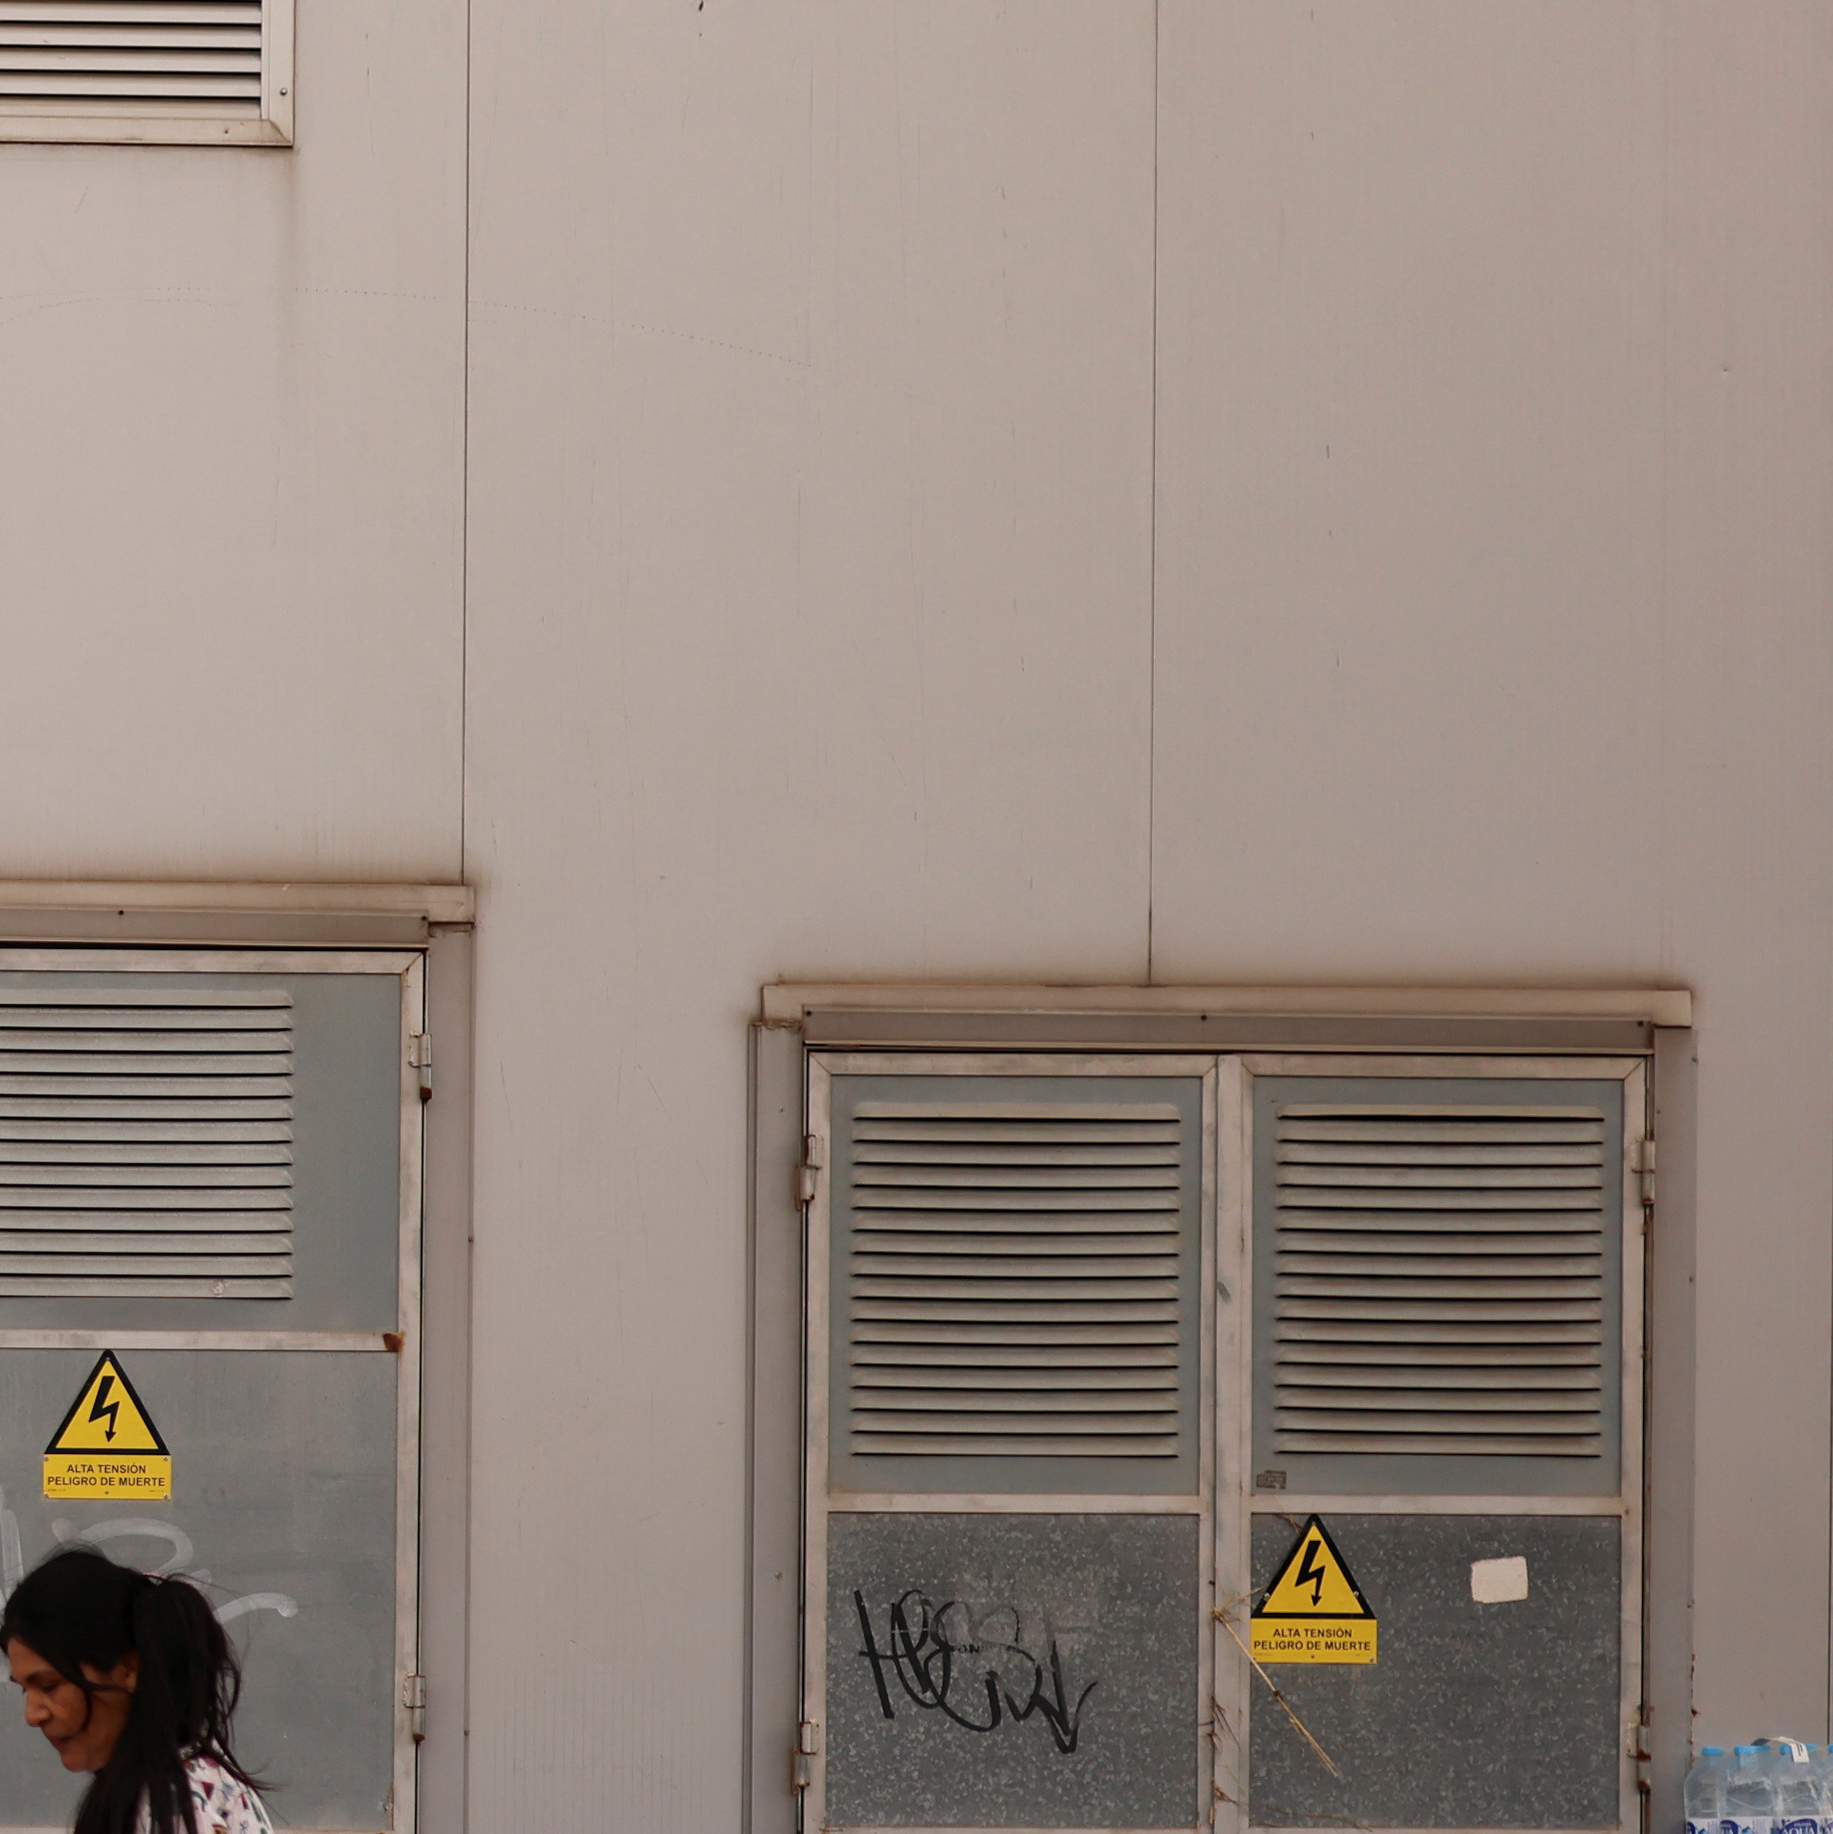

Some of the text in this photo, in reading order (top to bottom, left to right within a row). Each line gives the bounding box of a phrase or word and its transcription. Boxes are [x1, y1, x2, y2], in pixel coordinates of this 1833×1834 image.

[67, 1462, 147, 1474] ALTA TENSIÓN
[47, 1476, 166, 1486] PELIGRO DE MUERTE
[1273, 1626, 1353, 1638] ALTA TENSIÓN
[1254, 1641, 1371, 1651] PELIGRO DE MUERTE
